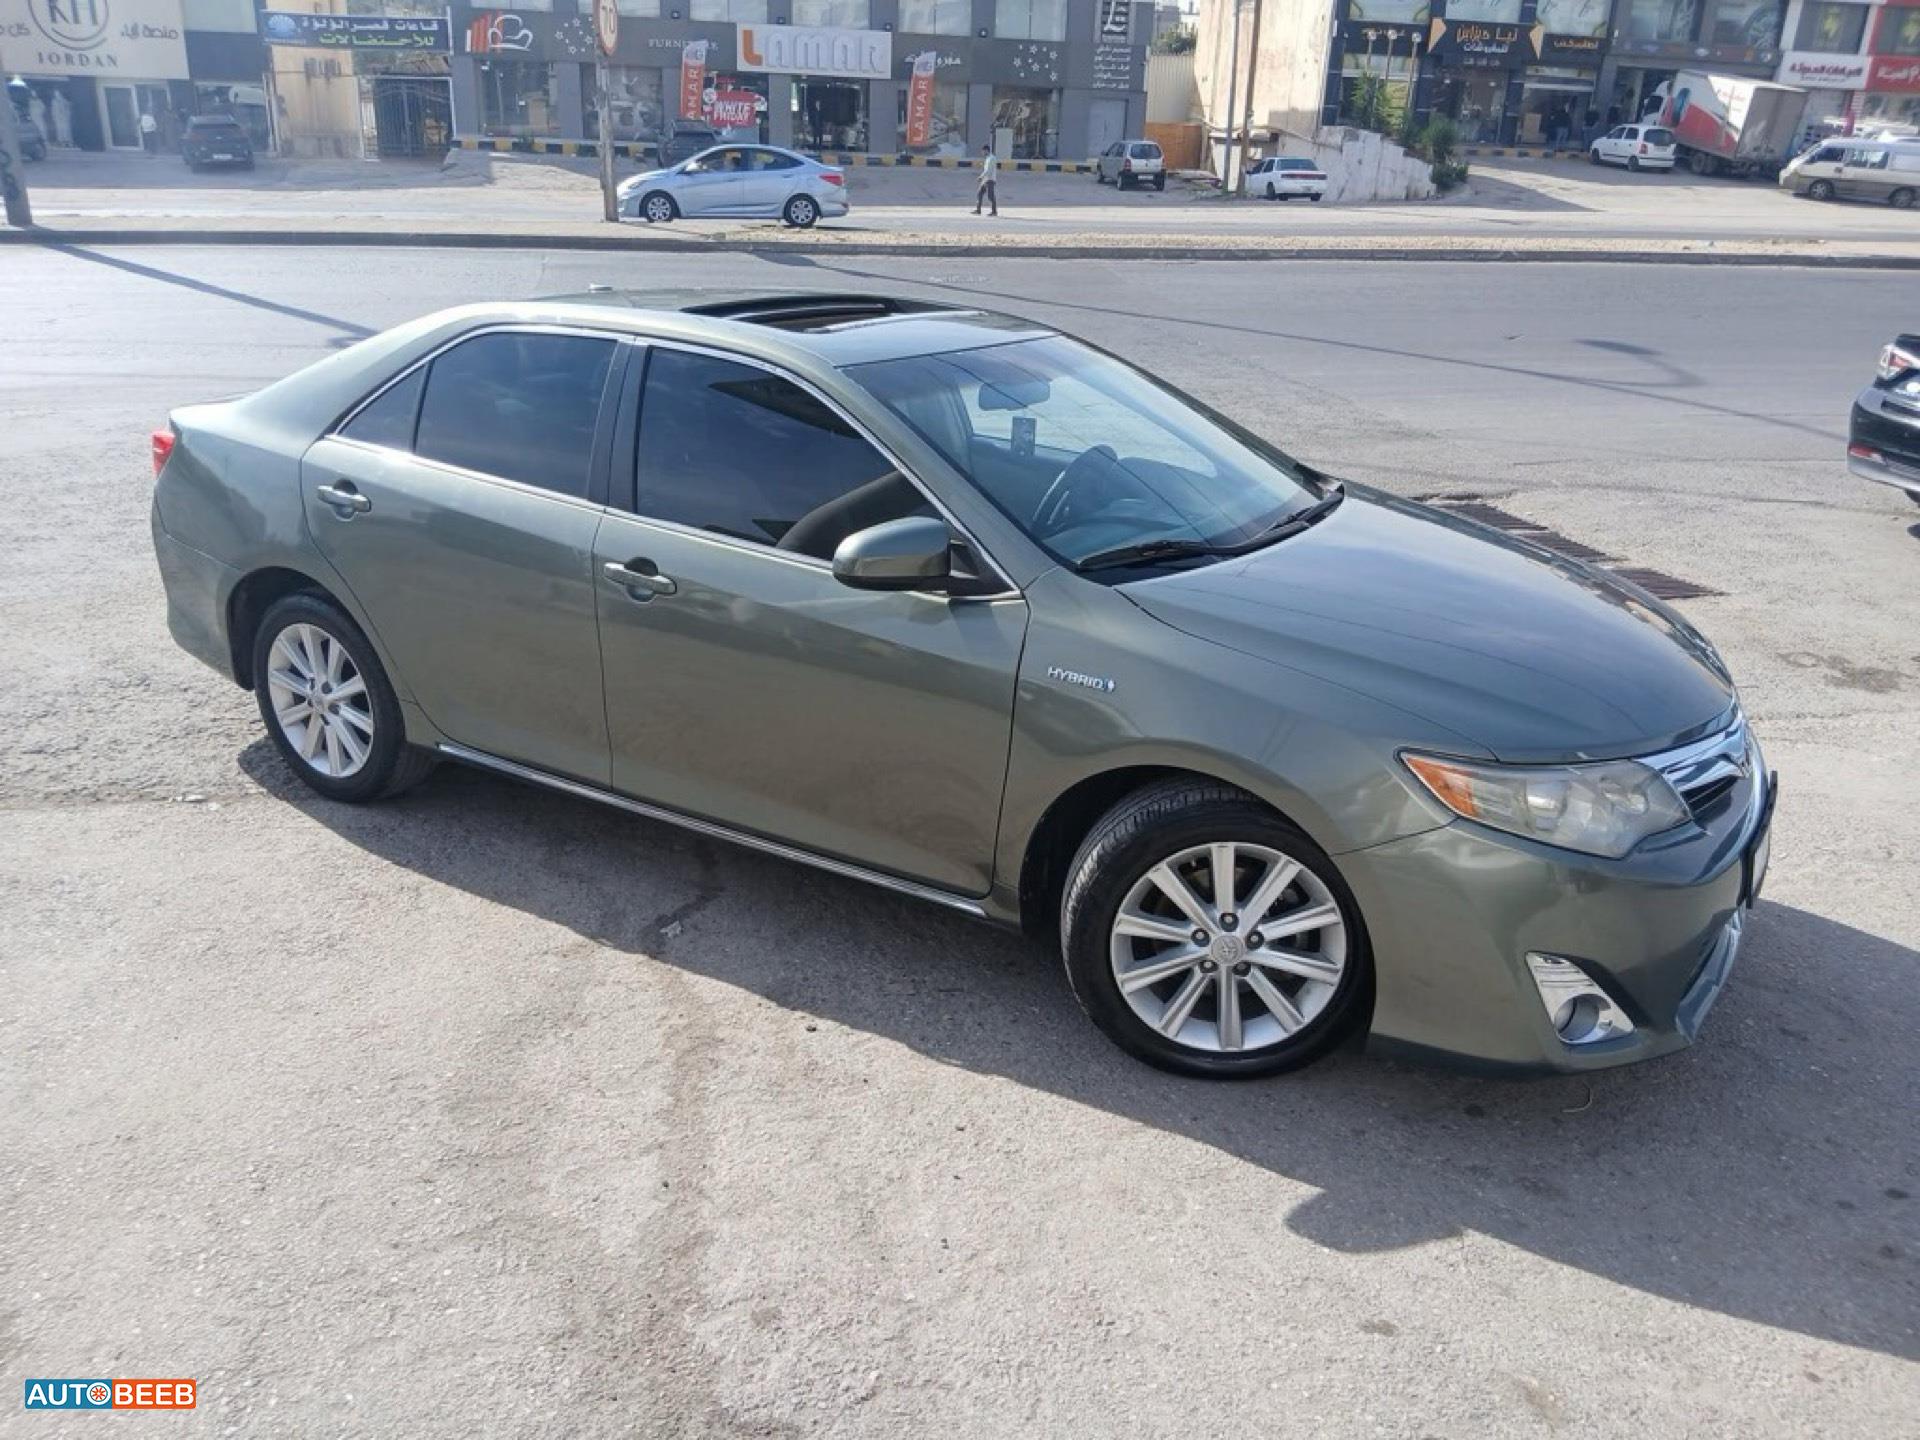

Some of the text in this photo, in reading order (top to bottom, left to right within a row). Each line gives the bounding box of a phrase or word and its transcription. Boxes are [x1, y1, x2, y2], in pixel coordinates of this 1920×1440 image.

[351, 20, 390, 32] قصر
[648, 39, 720, 52] FURNIE
[686, 67, 699, 120] AMAR
[714, 99, 751, 112] WHITE
[912, 79, 929, 142] LAMAR
[1047, 665, 1104, 690] HYBRID
